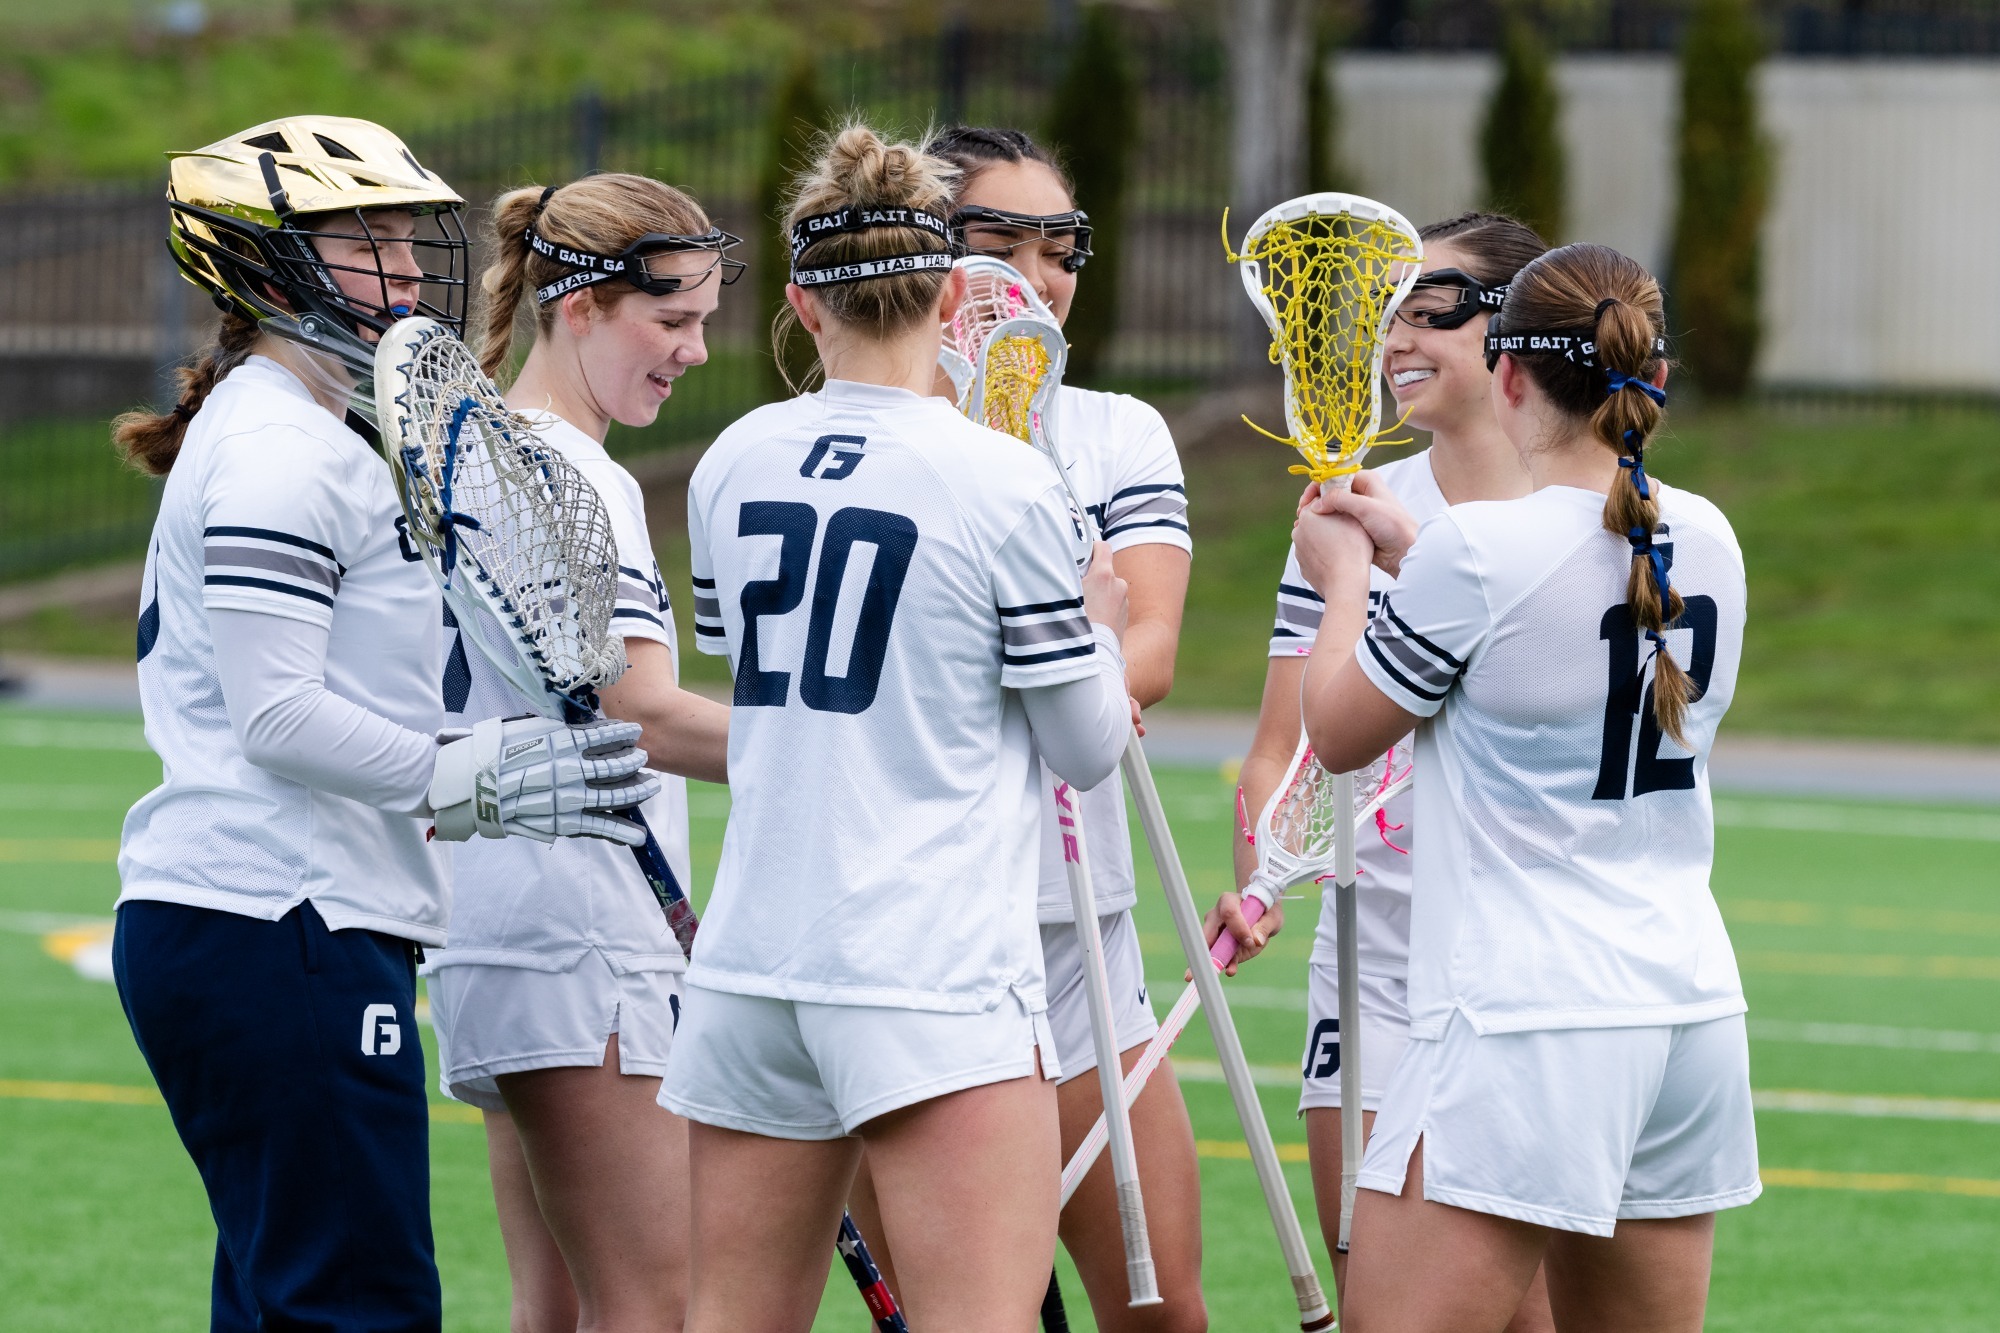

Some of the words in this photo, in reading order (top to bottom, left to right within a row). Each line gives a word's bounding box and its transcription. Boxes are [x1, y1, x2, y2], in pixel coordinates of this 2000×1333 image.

[809, 210, 849, 232] GAIT
[861, 209, 907, 223] GAIT
[914, 212, 944, 234] GAIT
[532, 235, 555, 256] GAIT
[559, 249, 597, 268] GAIT
[603, 259, 625, 272] GA
[1479, 290, 1505, 306] AIT
[1500, 336, 1524, 350] GAIT
[1530, 336, 1571, 349] GAIT
[733, 501, 919, 715] 20
[1591, 594, 1718, 801] 12
